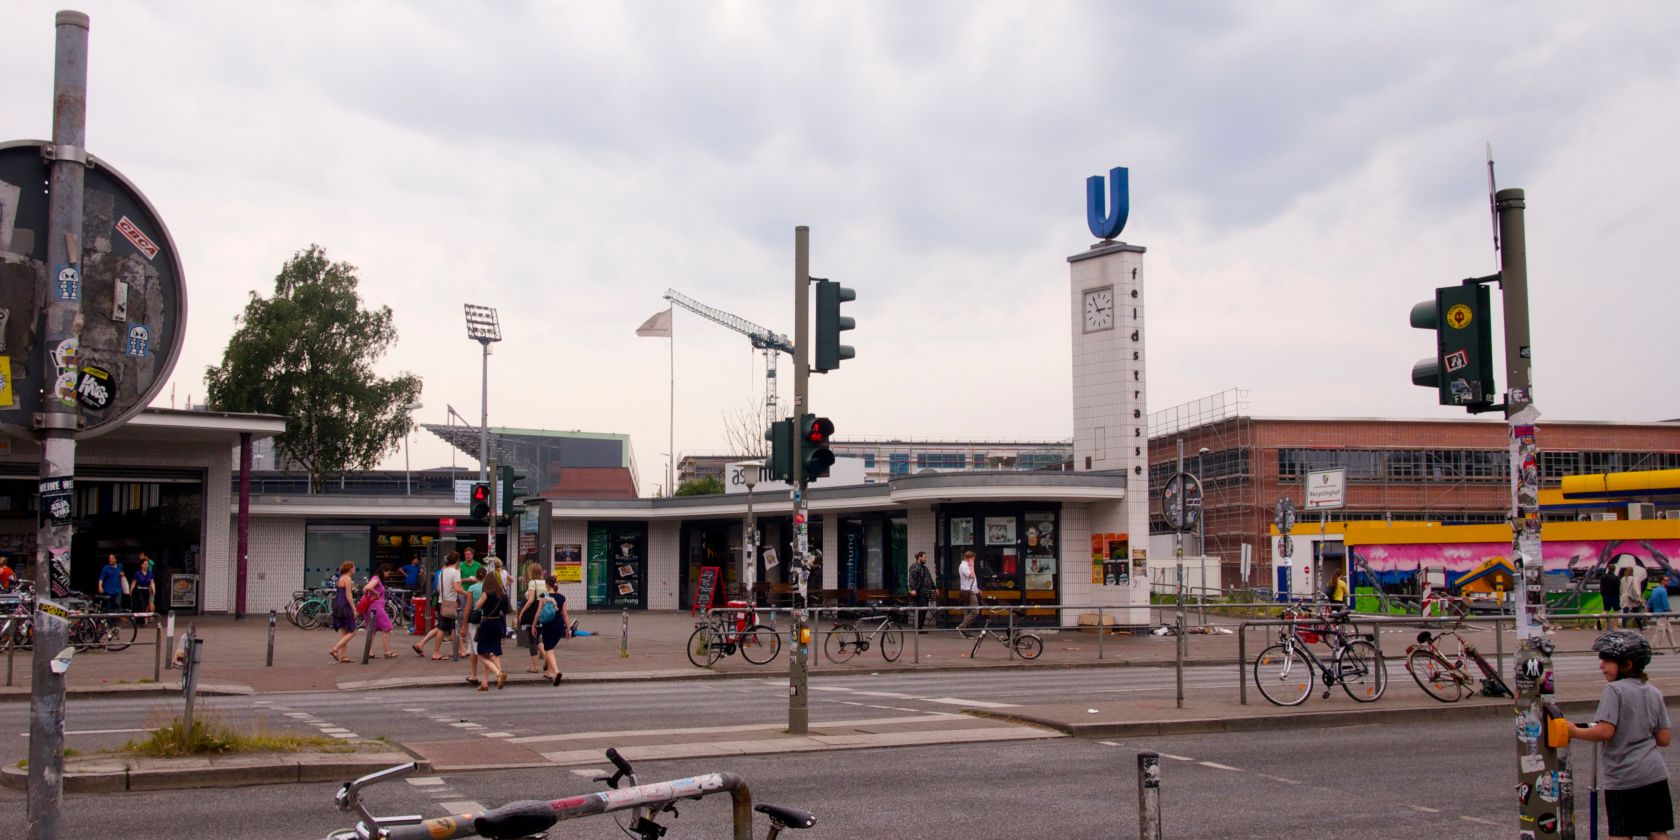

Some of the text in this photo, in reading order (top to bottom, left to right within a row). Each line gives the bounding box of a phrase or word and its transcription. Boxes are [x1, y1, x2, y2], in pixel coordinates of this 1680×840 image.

[1087, 167, 1129, 239] U
[1130, 267, 1143, 476] feldstrasse
[1309, 489, 1341, 498] Recyclinghof
